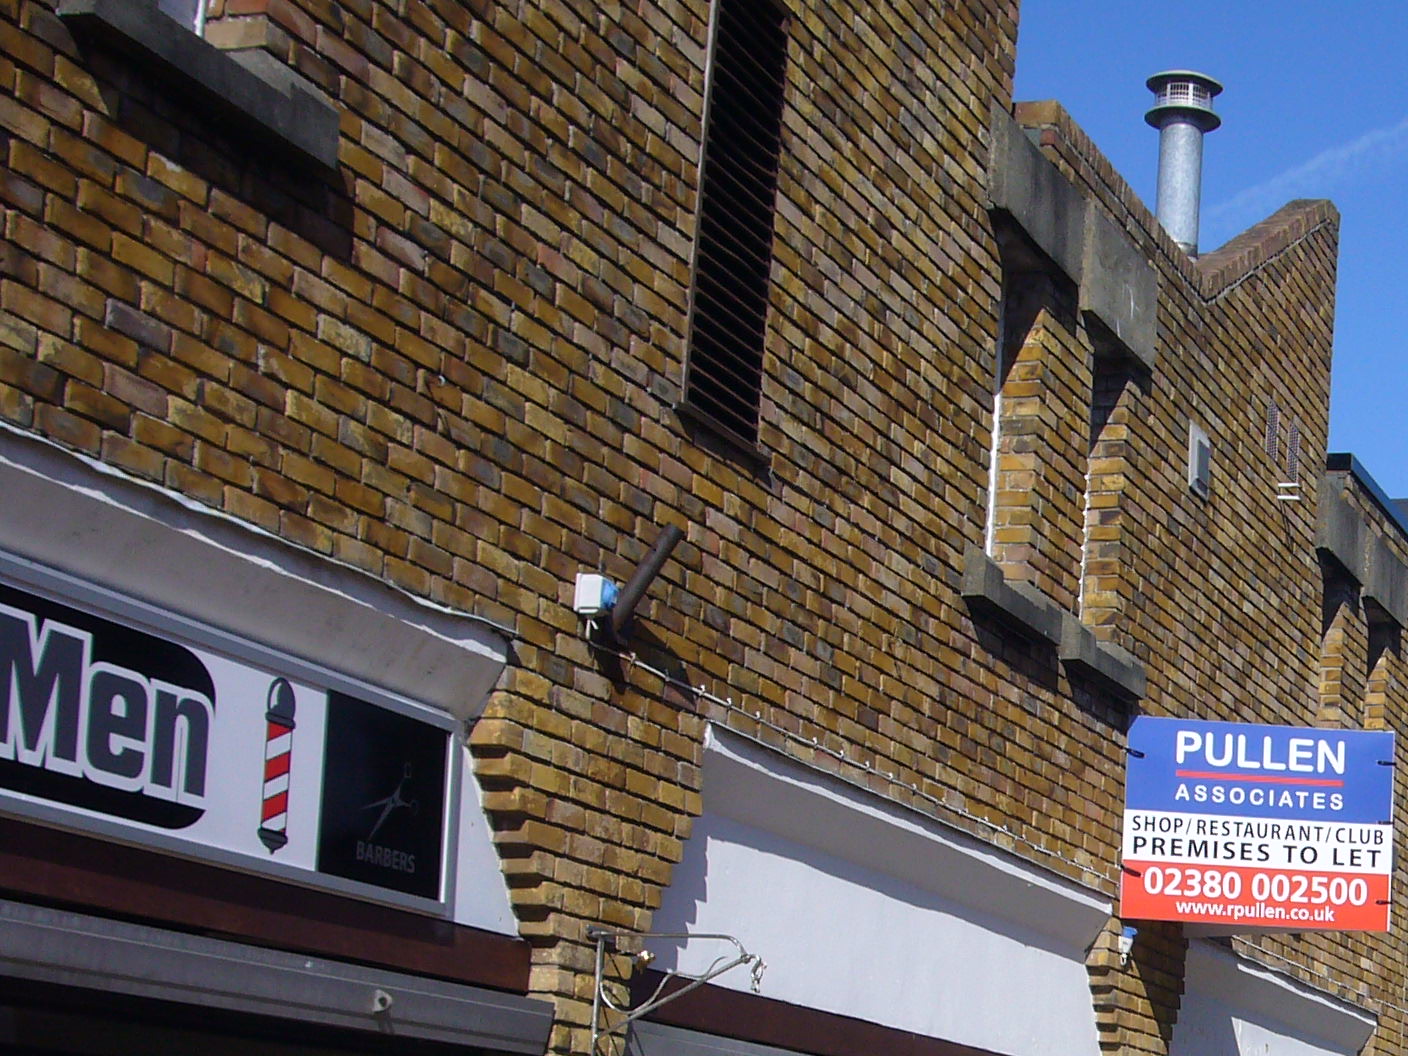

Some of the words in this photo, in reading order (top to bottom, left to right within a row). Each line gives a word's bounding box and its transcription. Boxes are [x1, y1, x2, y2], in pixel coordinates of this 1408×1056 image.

[0, 606, 212, 808] Men
[1176, 730, 1345, 775] PULLEN
[1175, 784, 1344, 810] ASSOCIATES
[1132, 815, 1384, 845] SHOP/RESTAURANT/CLUB
[356, 840, 416, 873] BARBERS
[1133, 836, 1270, 862] PREMISES
[1284, 845, 1318, 864] TO
[1333, 848, 1381, 868] LET
[1144, 867, 1242, 900] 02380
[1251, 873, 1368, 905] 002500
[1176, 901, 1334, 922] www.rpullen.co.uk
